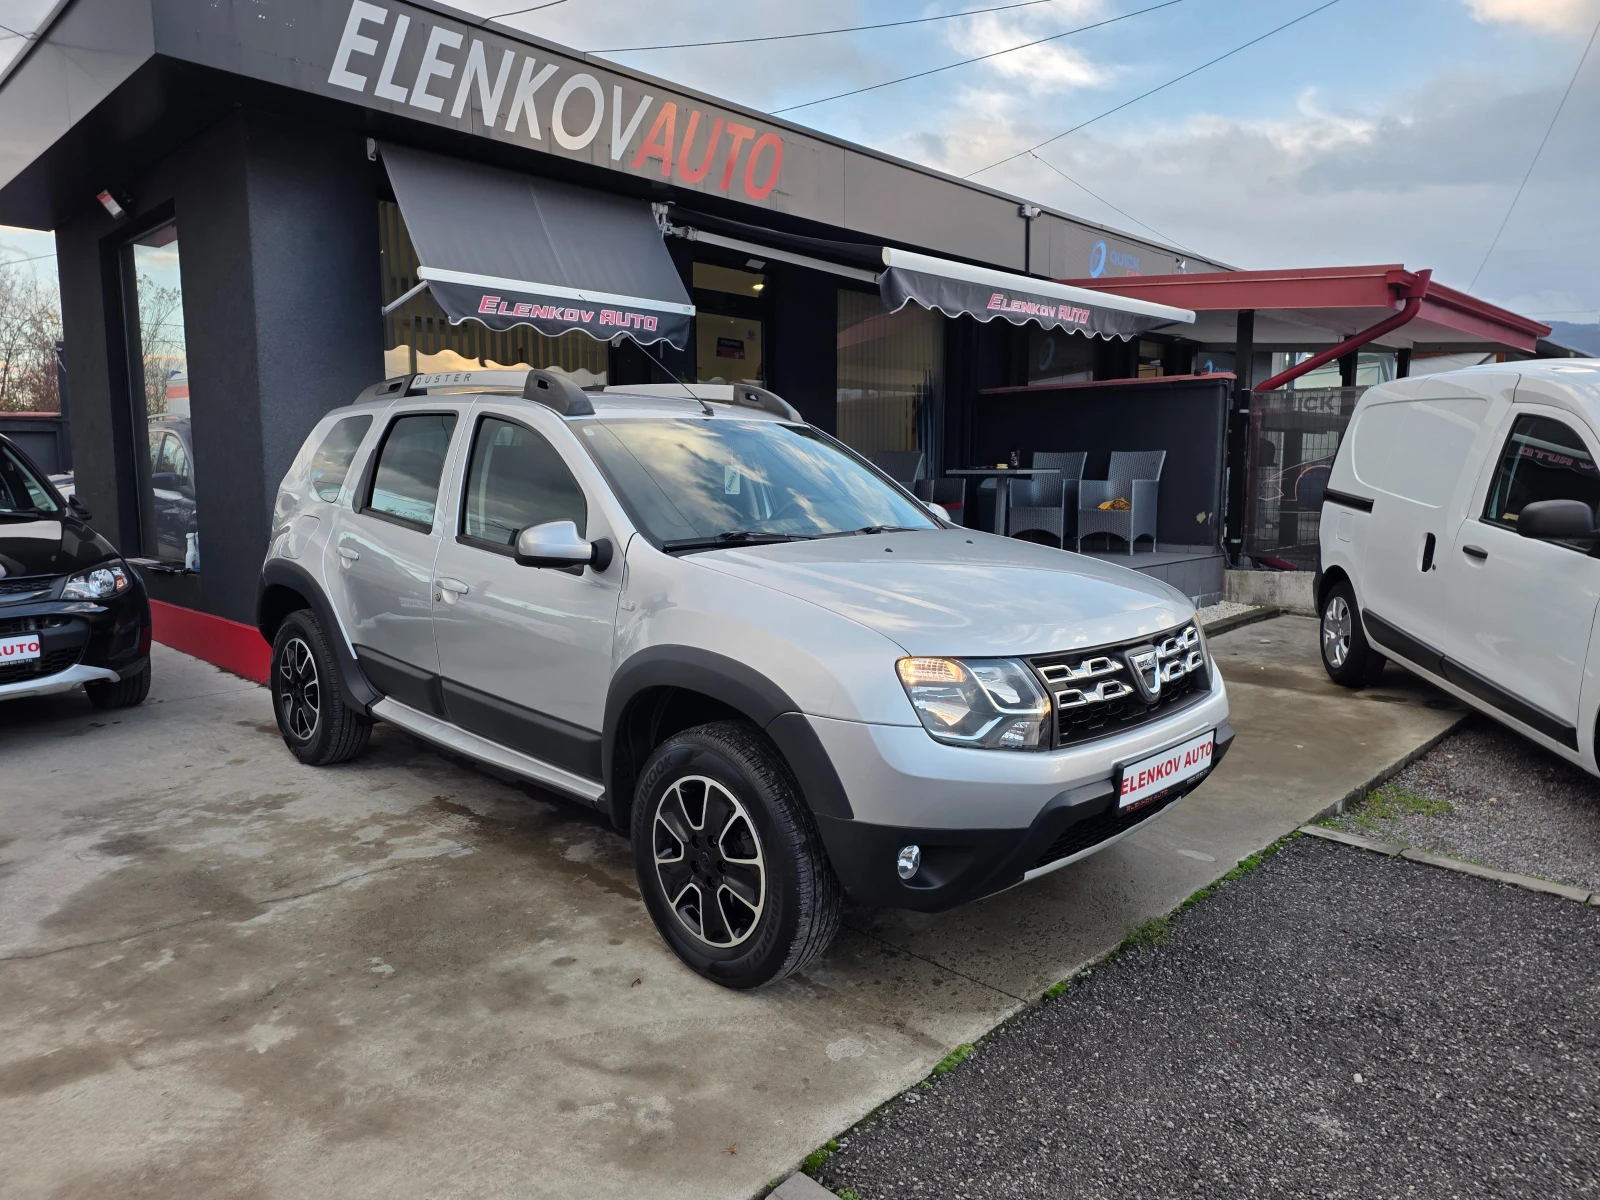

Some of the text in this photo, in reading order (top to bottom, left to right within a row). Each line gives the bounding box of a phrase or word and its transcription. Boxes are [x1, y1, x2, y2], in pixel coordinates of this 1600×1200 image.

[1109, 249, 1140, 271] QUICK
[478, 295, 658, 331] ELENKOV AUTO
[987, 293, 1090, 324] ELENKOV AUTO
[415, 373, 472, 385] DUSTER
[0, 642, 39, 656] UTO
[1121, 755, 1181, 796] ELENKOV
[1184, 741, 1213, 768] AUTO
